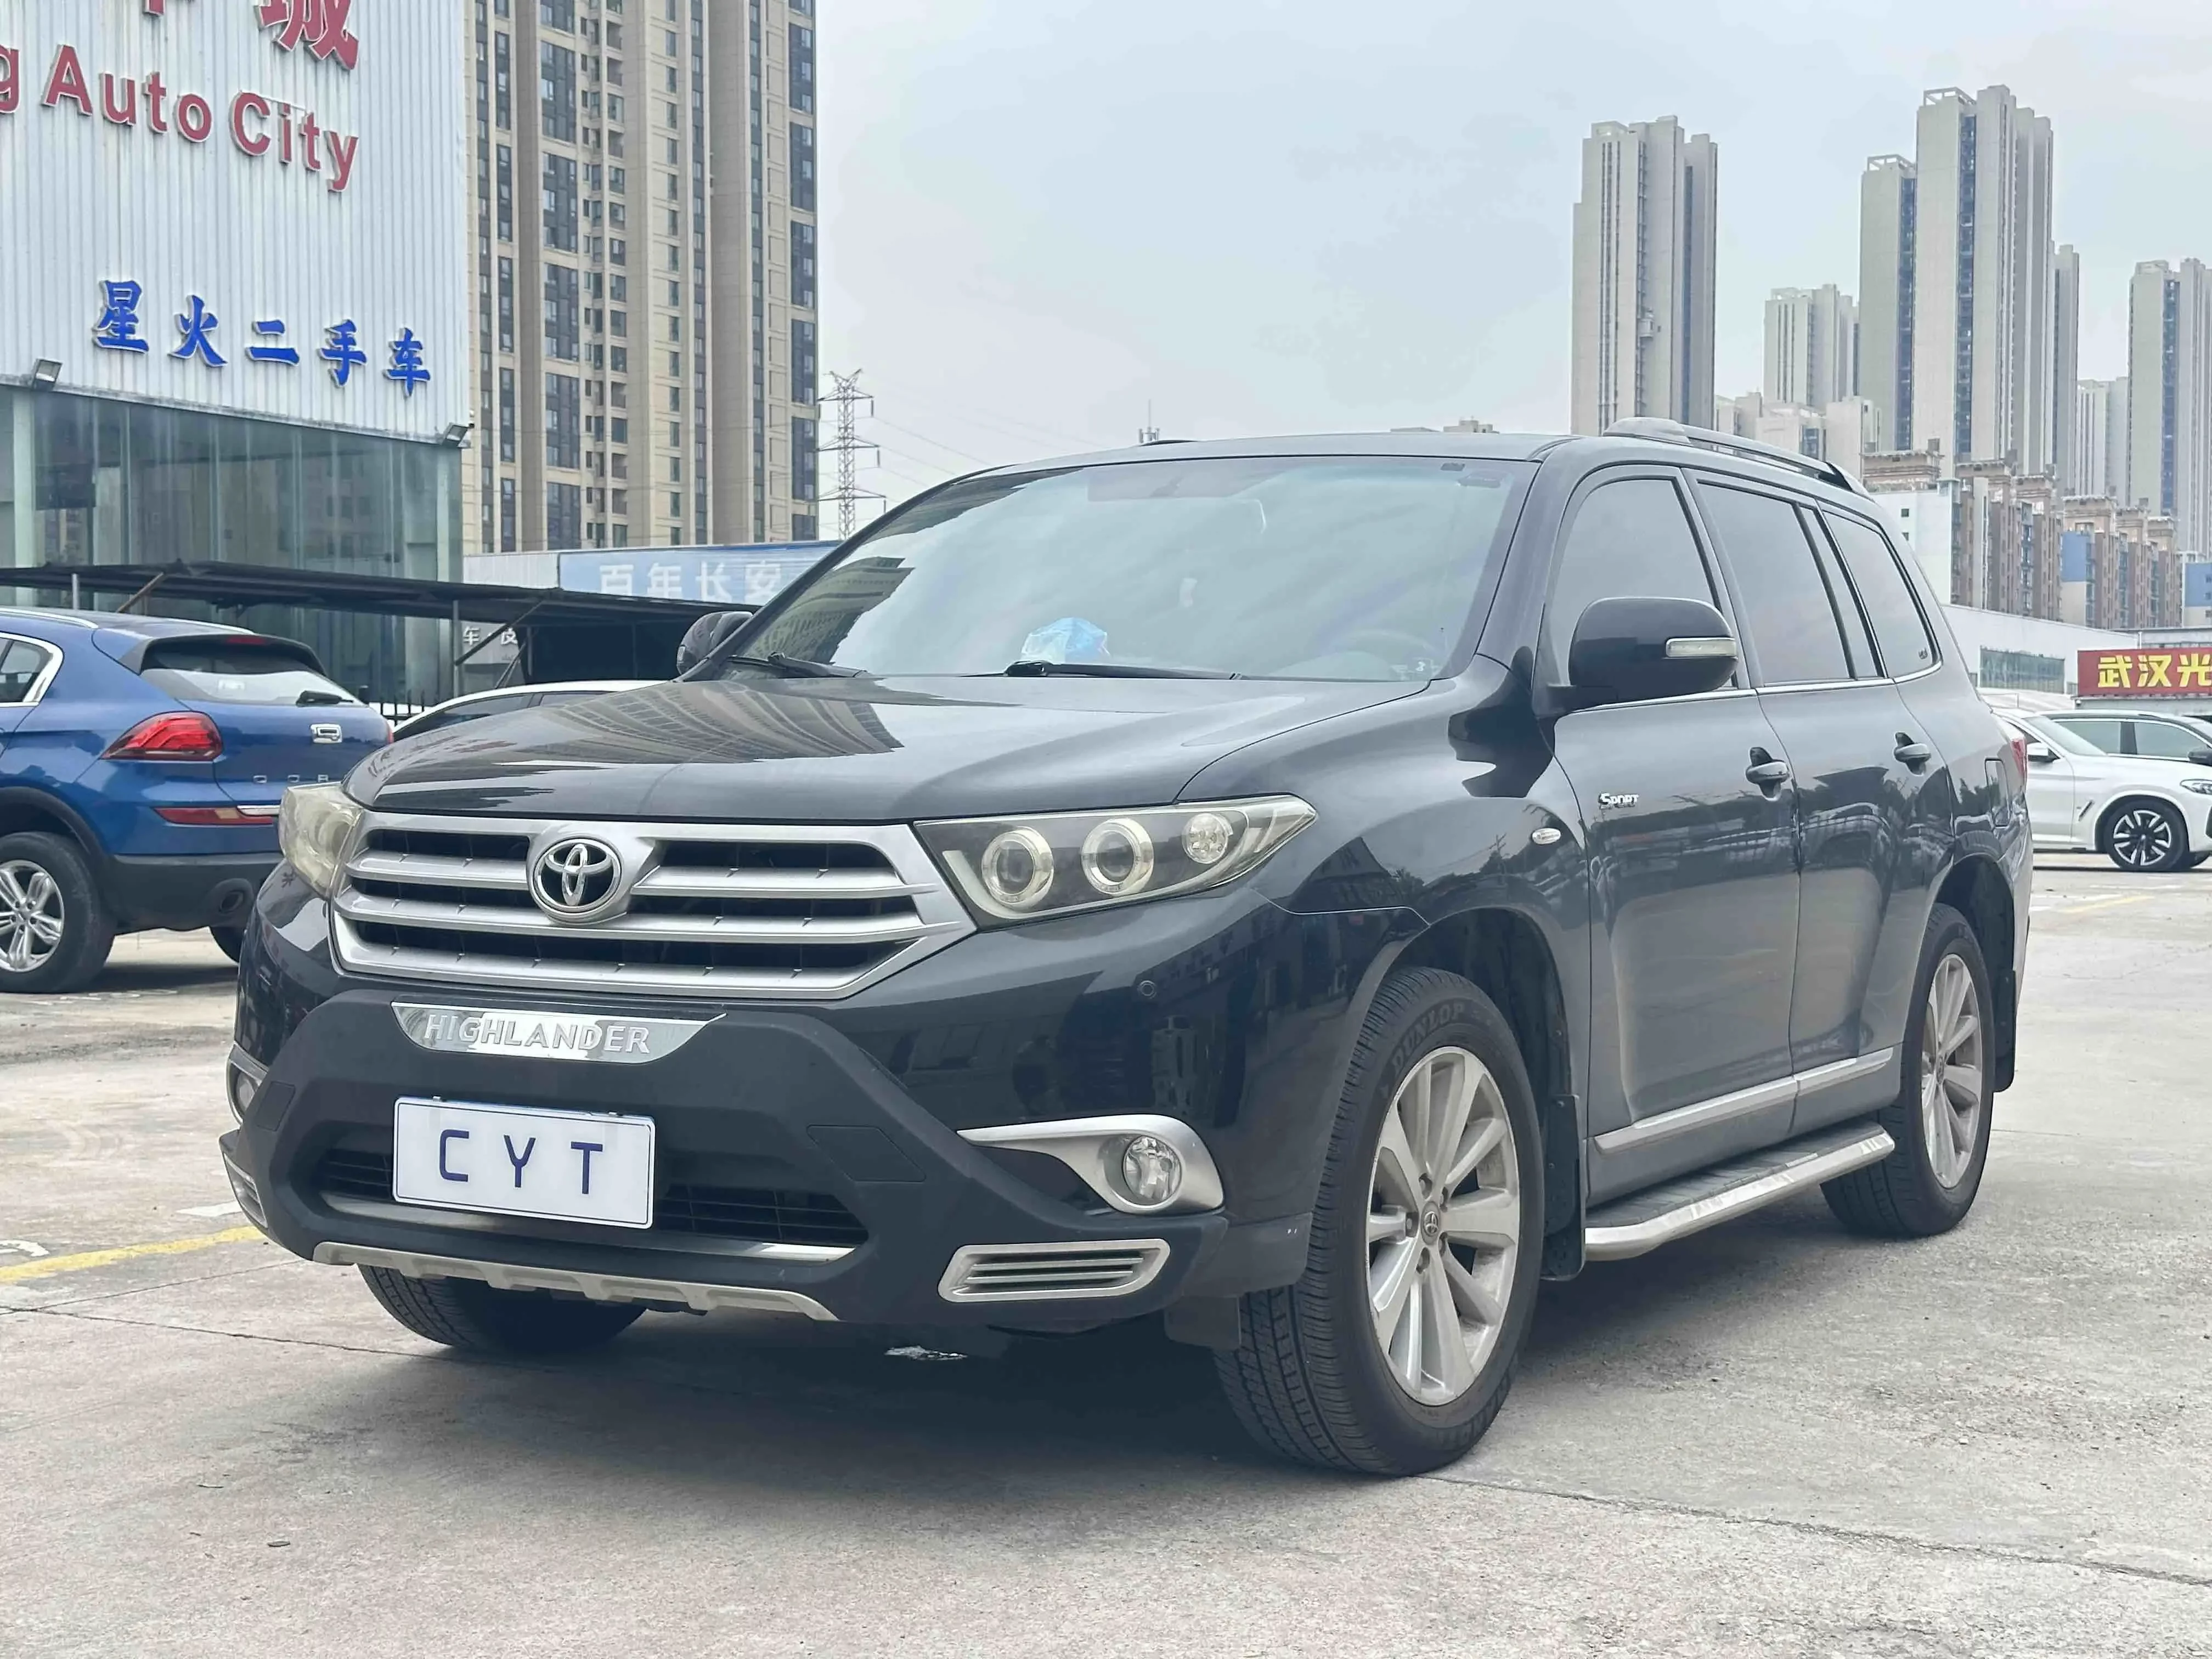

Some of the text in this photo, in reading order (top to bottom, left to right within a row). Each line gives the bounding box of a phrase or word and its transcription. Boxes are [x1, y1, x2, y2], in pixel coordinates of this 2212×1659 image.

[42, 44, 213, 143] Auto
[229, 90, 359, 192] City
[93, 280, 431, 398] 星火二手车
[599, 560, 781, 605] 百年长安
[2097, 653, 2212, 689] 武汉光
[424, 1013, 651, 1054] HIGHLANDER
